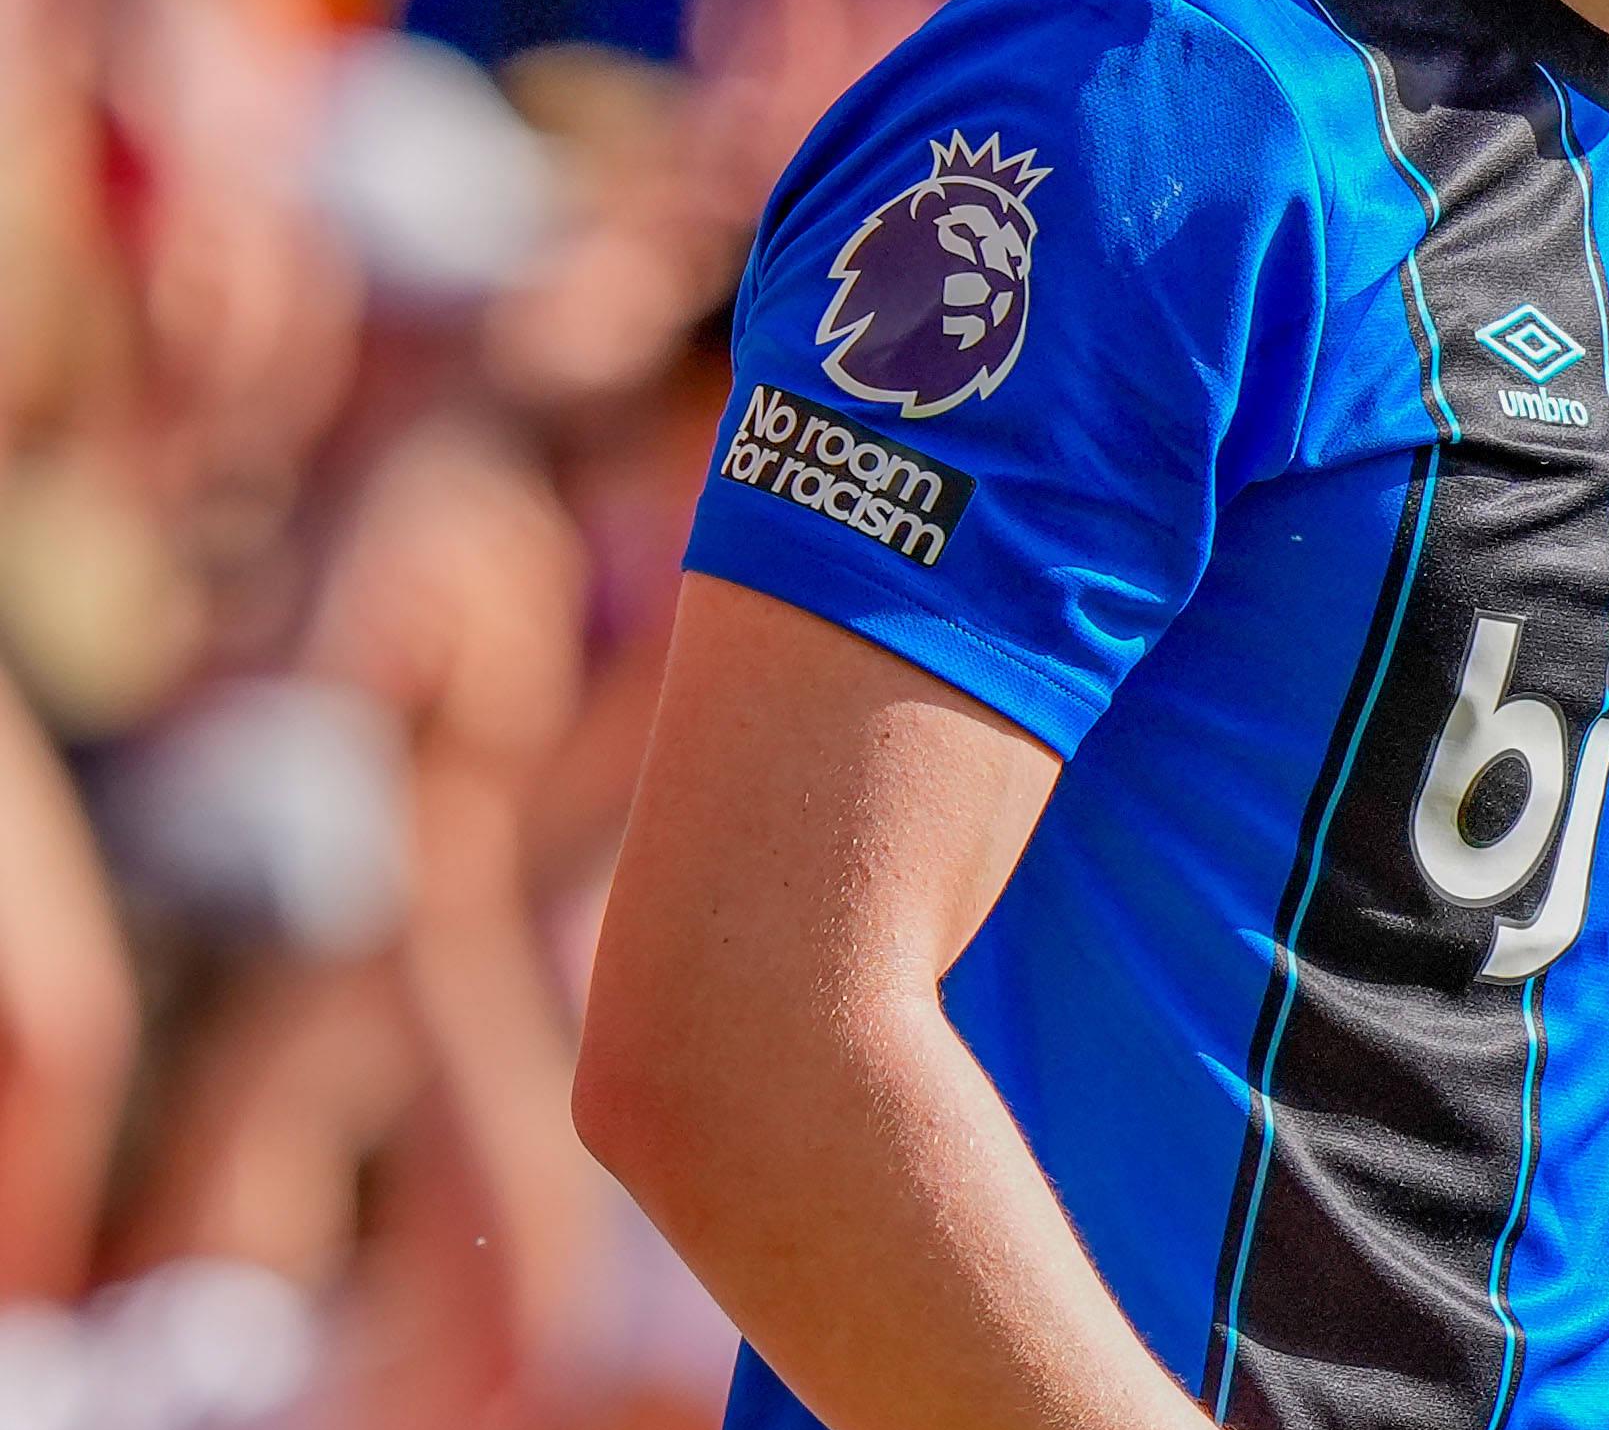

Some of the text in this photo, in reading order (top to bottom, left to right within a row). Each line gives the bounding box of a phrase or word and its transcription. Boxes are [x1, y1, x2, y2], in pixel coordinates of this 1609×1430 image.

[738, 384, 943, 514] No room
[1497, 386, 1589, 428] umbro
[720, 430, 947, 567] for racism
